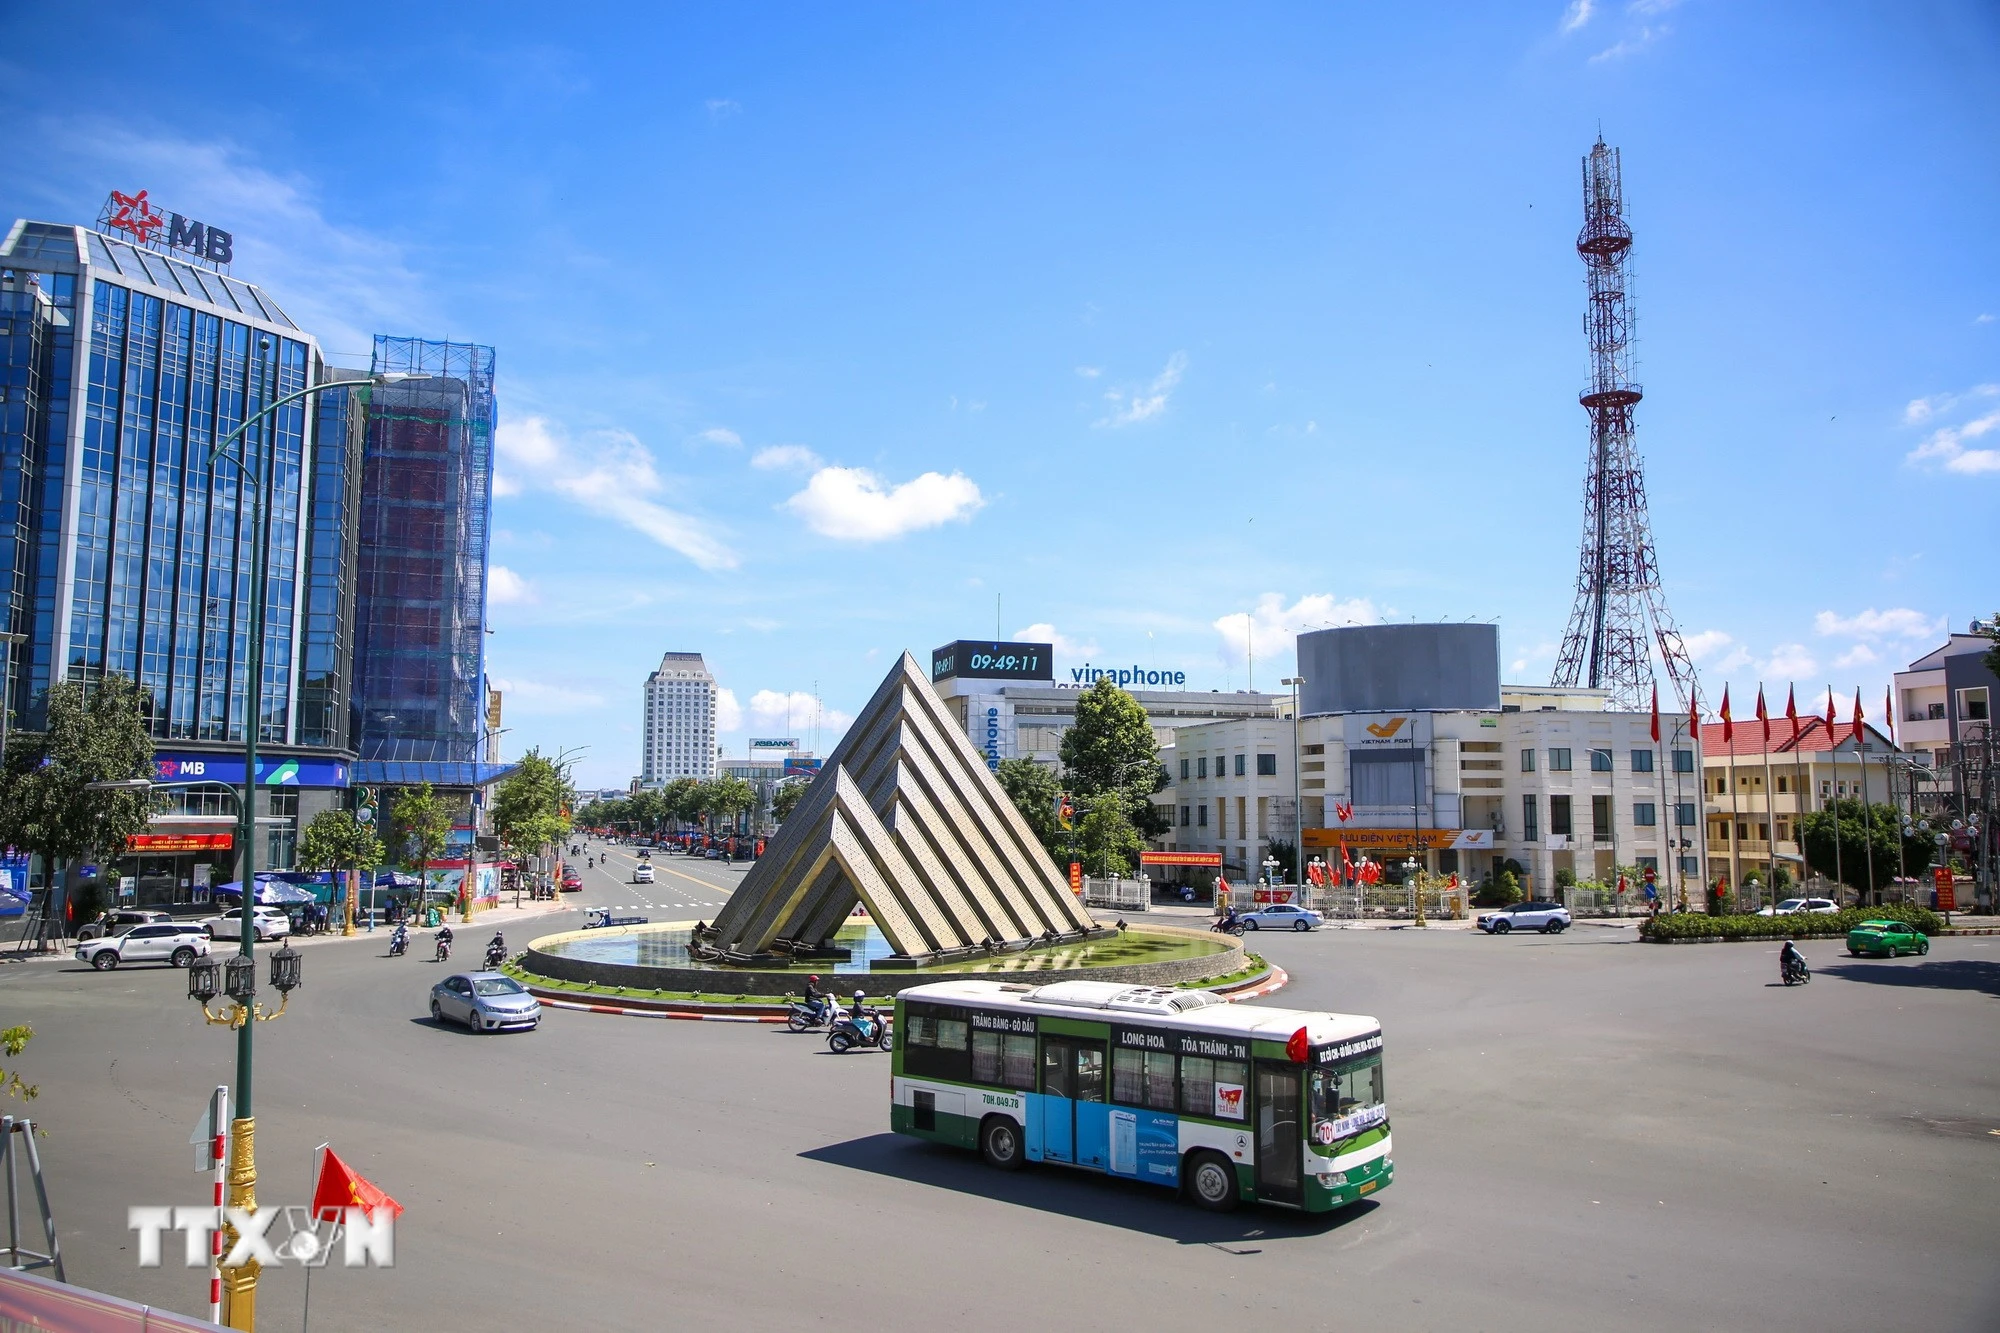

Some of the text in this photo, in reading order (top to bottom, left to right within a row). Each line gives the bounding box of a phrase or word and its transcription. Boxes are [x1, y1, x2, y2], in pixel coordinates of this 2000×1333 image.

[169, 213, 233, 263] MB
[970, 654, 1038, 671] 09:49:11
[1071, 663, 1186, 688] vinaphone
[985, 707, 1000, 772] aphone
[180, 761, 205, 775] MB
[1361, 833, 1383, 844] ĐIỆN
[1387, 833, 1409, 844] VIỆT
[1122, 1032, 1165, 1048] LONG HOA
[1181, 1036, 1198, 1053] TÒA
[1199, 1040, 1228, 1056] THÁNH
[1233, 1045, 1246, 1058] TN
[982, 1093, 1019, 1108] 70H.049.78
[1321, 1125, 1333, 1141] 701
